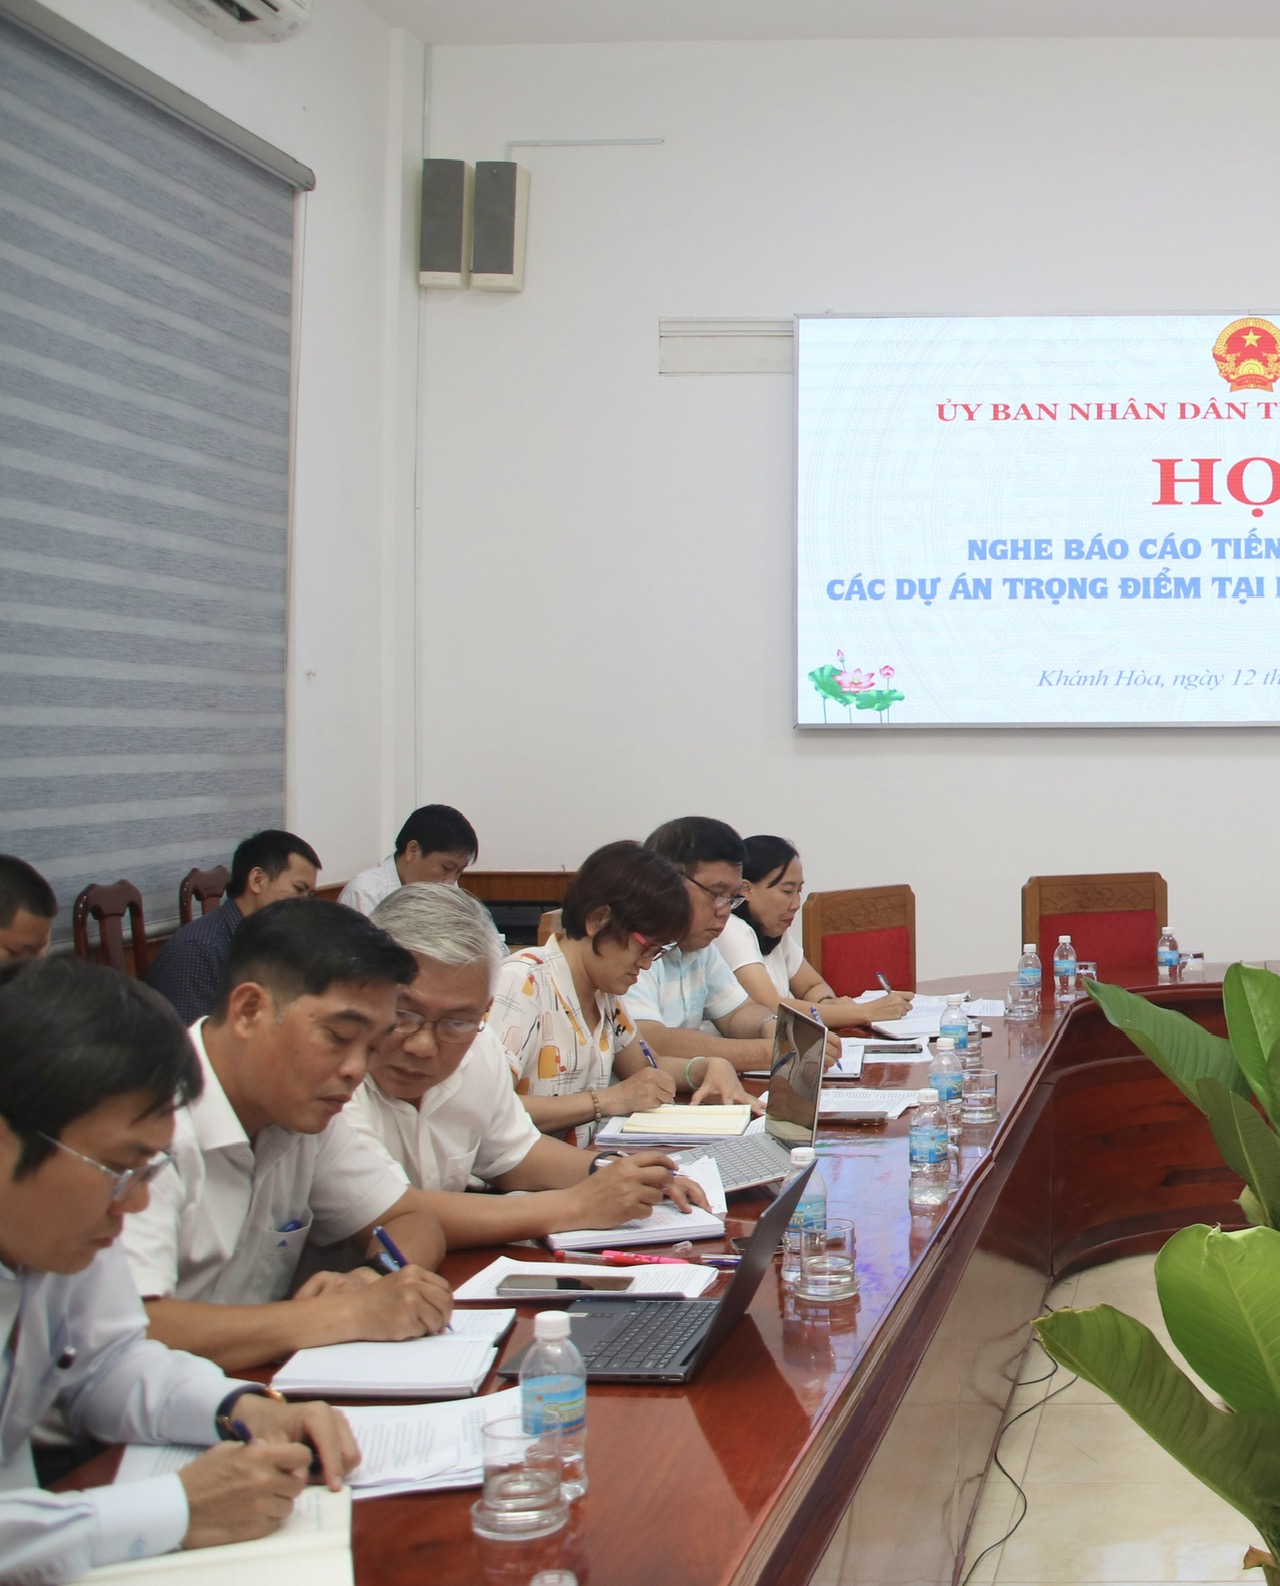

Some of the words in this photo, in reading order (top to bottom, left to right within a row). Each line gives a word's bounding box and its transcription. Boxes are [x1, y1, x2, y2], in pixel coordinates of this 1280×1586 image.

[936, 398, 982, 421] ỦY
[990, 402, 1059, 421] BAN
[1069, 397, 1167, 420] NHÂN
[1177, 396, 1248, 420] DÂN
[967, 538, 1053, 561] NGHE
[1064, 533, 1129, 560] BÁO
[1139, 532, 1202, 560] CÁO
[826, 573, 885, 601] CÁC
[896, 577, 941, 605] DỰ
[949, 573, 992, 600] ÁN
[1003, 577, 1108, 605] TRỌNG
[1118, 567, 1201, 599] ĐIỂM
[1212, 576, 1265, 604] TẠI
[1037, 669, 1108, 687] Khánh
[1114, 669, 1165, 688] Hòa,
[1173, 669, 1225, 690] ngày
[1233, 669, 1257, 686] 12
